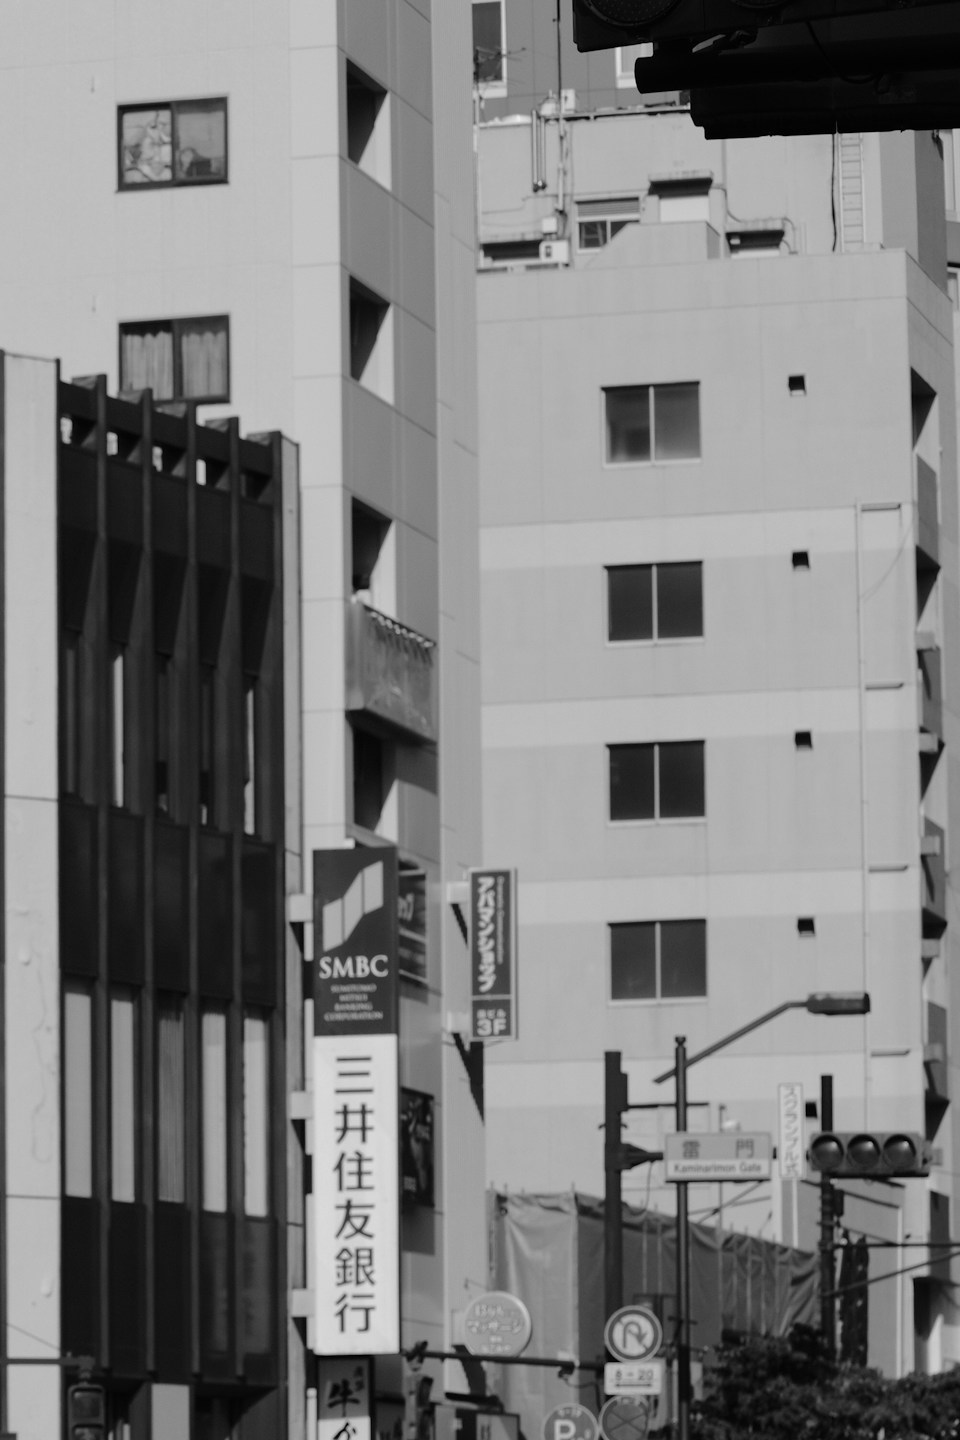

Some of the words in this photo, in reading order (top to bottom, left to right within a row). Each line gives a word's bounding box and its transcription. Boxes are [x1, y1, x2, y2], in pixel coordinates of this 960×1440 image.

[477, 876, 496, 992] アパマンショップ
[319, 954, 389, 979] SMBC
[477, 1018, 507, 1036] 3F
[683, 1138, 755, 1159] 雷門
[674, 1164, 737, 1174] Kaminarimon
[739, 1162, 762, 1172] Gate
[333, 1056, 376, 1333] 三井住友銀行
[638, 1369, 653, 1381] 20
